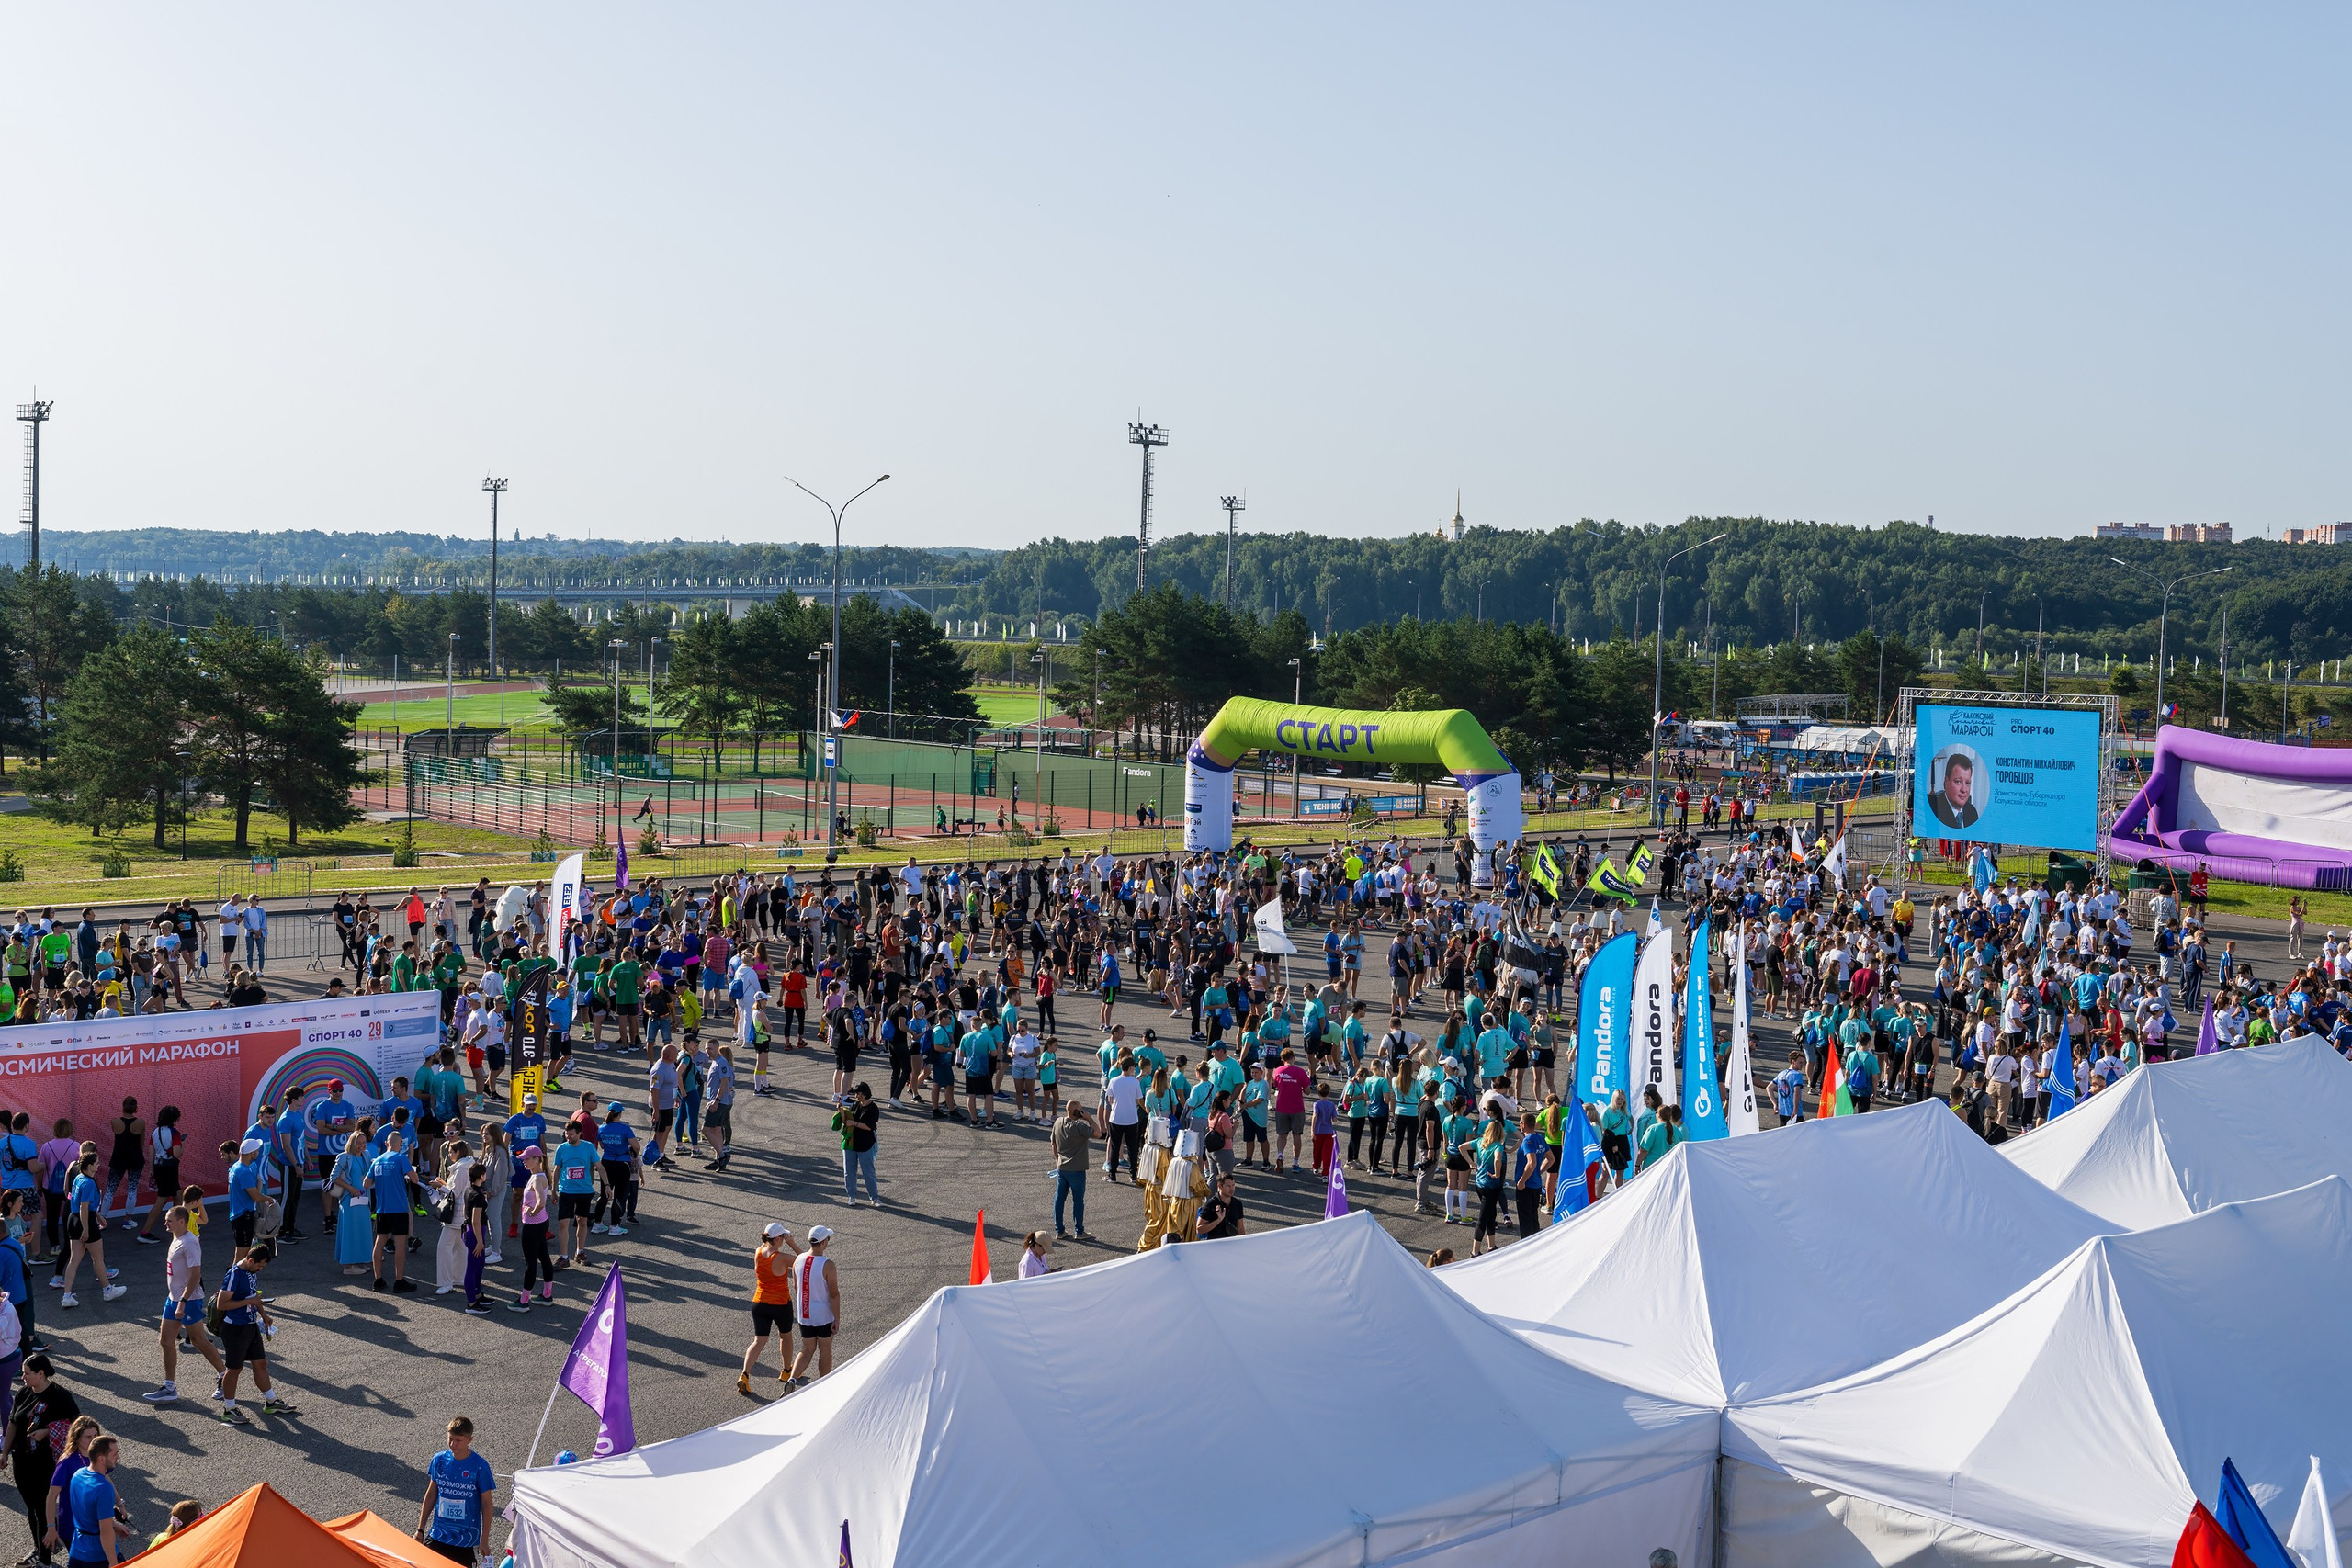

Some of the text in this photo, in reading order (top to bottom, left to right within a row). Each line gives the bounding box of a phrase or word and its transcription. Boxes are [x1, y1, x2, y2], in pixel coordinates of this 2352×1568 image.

[1963, 712, 1994, 720] КАЛУЖСКИЙ
[1276, 719, 1380, 754] СТАРТ
[1951, 724, 1994, 737] МАРАФОН
[2010, 725, 2055, 735] СПОРТ 40
[1996, 757, 2076, 771] КОНСТАНТИН МИХАЙЛОВИЧ
[1123, 767, 1151, 777] Pandora
[1996, 772, 2034, 784] ГОРОБЦОВ
[1994, 789, 2065, 800] Заместитель Губернатора
[2025, 799, 2047, 807] области
[309, 1029, 362, 1042] СПОРТ 40
[369, 1021, 381, 1037] 29
[522, 1037, 536, 1058] ЭТО
[1591, 987, 1611, 1095] Pandora
[140, 1040, 239, 1064] МАРАФОН
[573, 1349, 608, 1380] АГРЕГАТО
[447, 1508, 463, 1517] 1532
